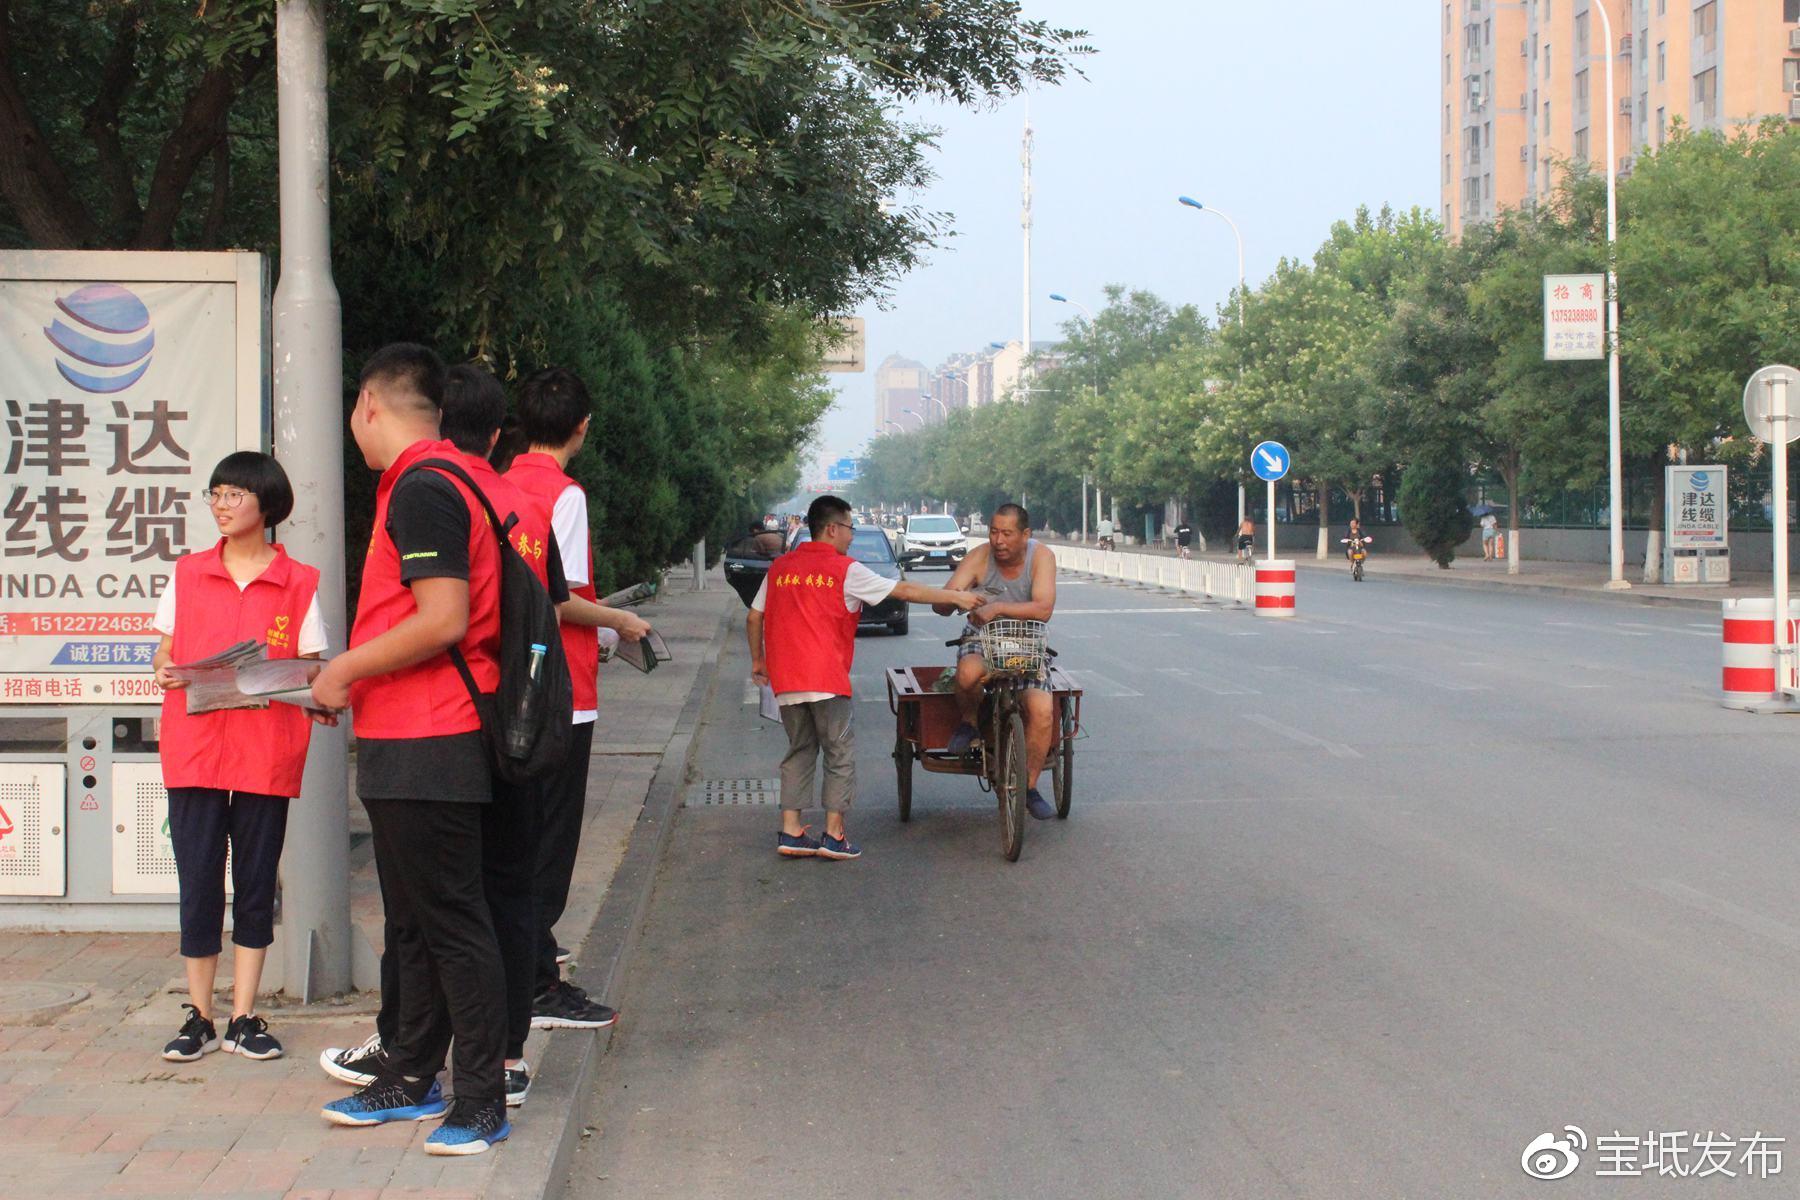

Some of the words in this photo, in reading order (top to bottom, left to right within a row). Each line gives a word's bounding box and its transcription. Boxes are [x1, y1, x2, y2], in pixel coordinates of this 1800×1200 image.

[4, 399, 191, 476] 津达
[1682, 492, 1715, 507] 津达
[3, 486, 191, 562] 线缆
[1682, 508, 1715, 522] 线缆
[5, 678, 82, 697] 招商电话
[110, 680, 166, 696] 139206
